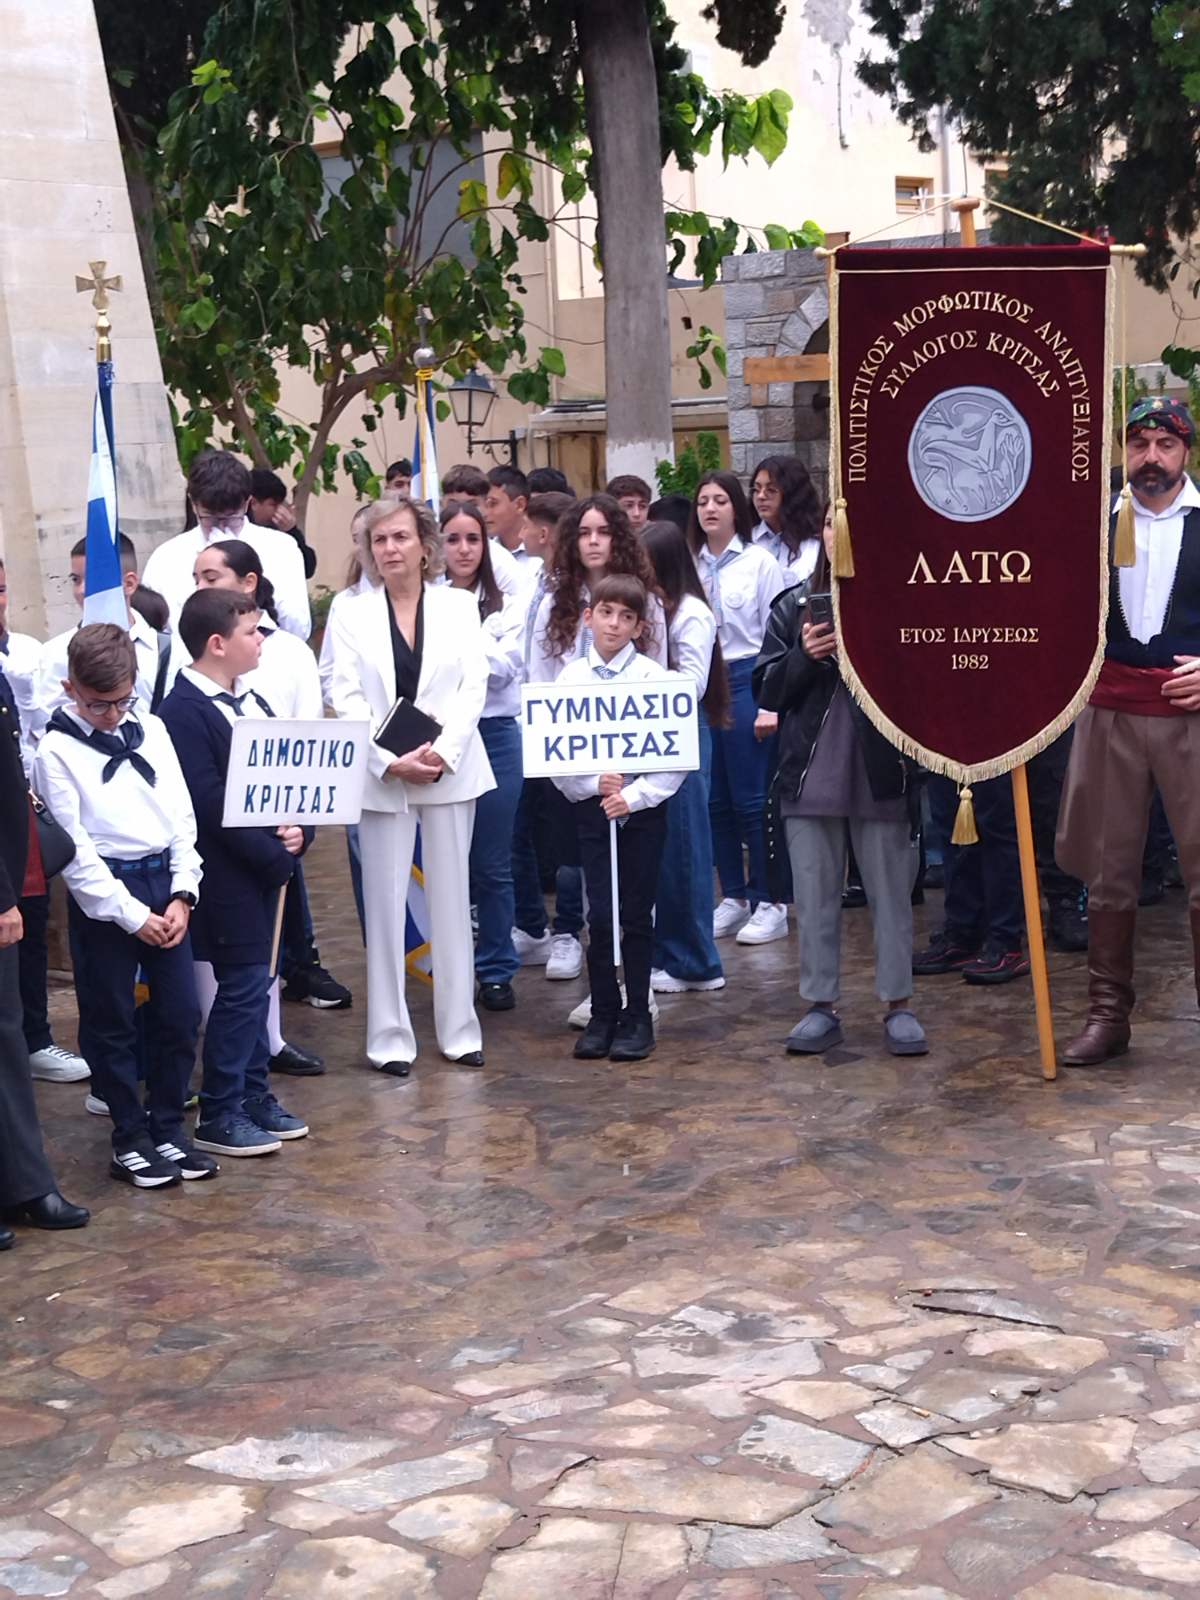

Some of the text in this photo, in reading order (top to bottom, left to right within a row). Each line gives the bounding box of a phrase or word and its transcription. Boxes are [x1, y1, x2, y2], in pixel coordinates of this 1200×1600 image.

[880, 330, 1060, 399] ΣΥΛΛΟΓΟΣ ΚΡΙΤΣΑΣ
[848, 291, 1090, 482] ΠΟΛΙΤΙΣΤΙΚΟΣ ΜΟΡΦΩΤΙΚΟΣ ΑΝΑΠΤΥΞΙΑΚΟΣ
[907, 550, 1032, 584] ΛΑΤΩ
[900, 627, 1039, 643] ΕΤΟΣ ΙΔΡΥΣΕΩΣ
[951, 654, 989, 670] 1982
[526, 692, 693, 725] ΓΥΜΝΑΣΙΟ
[247, 738, 355, 768] ΔΗΜΟΤΙΚΟ
[544, 730, 680, 762] ΚΡΙΤΣΑΣ
[243, 784, 337, 813] ΚΡΙΤΣΑΣ
